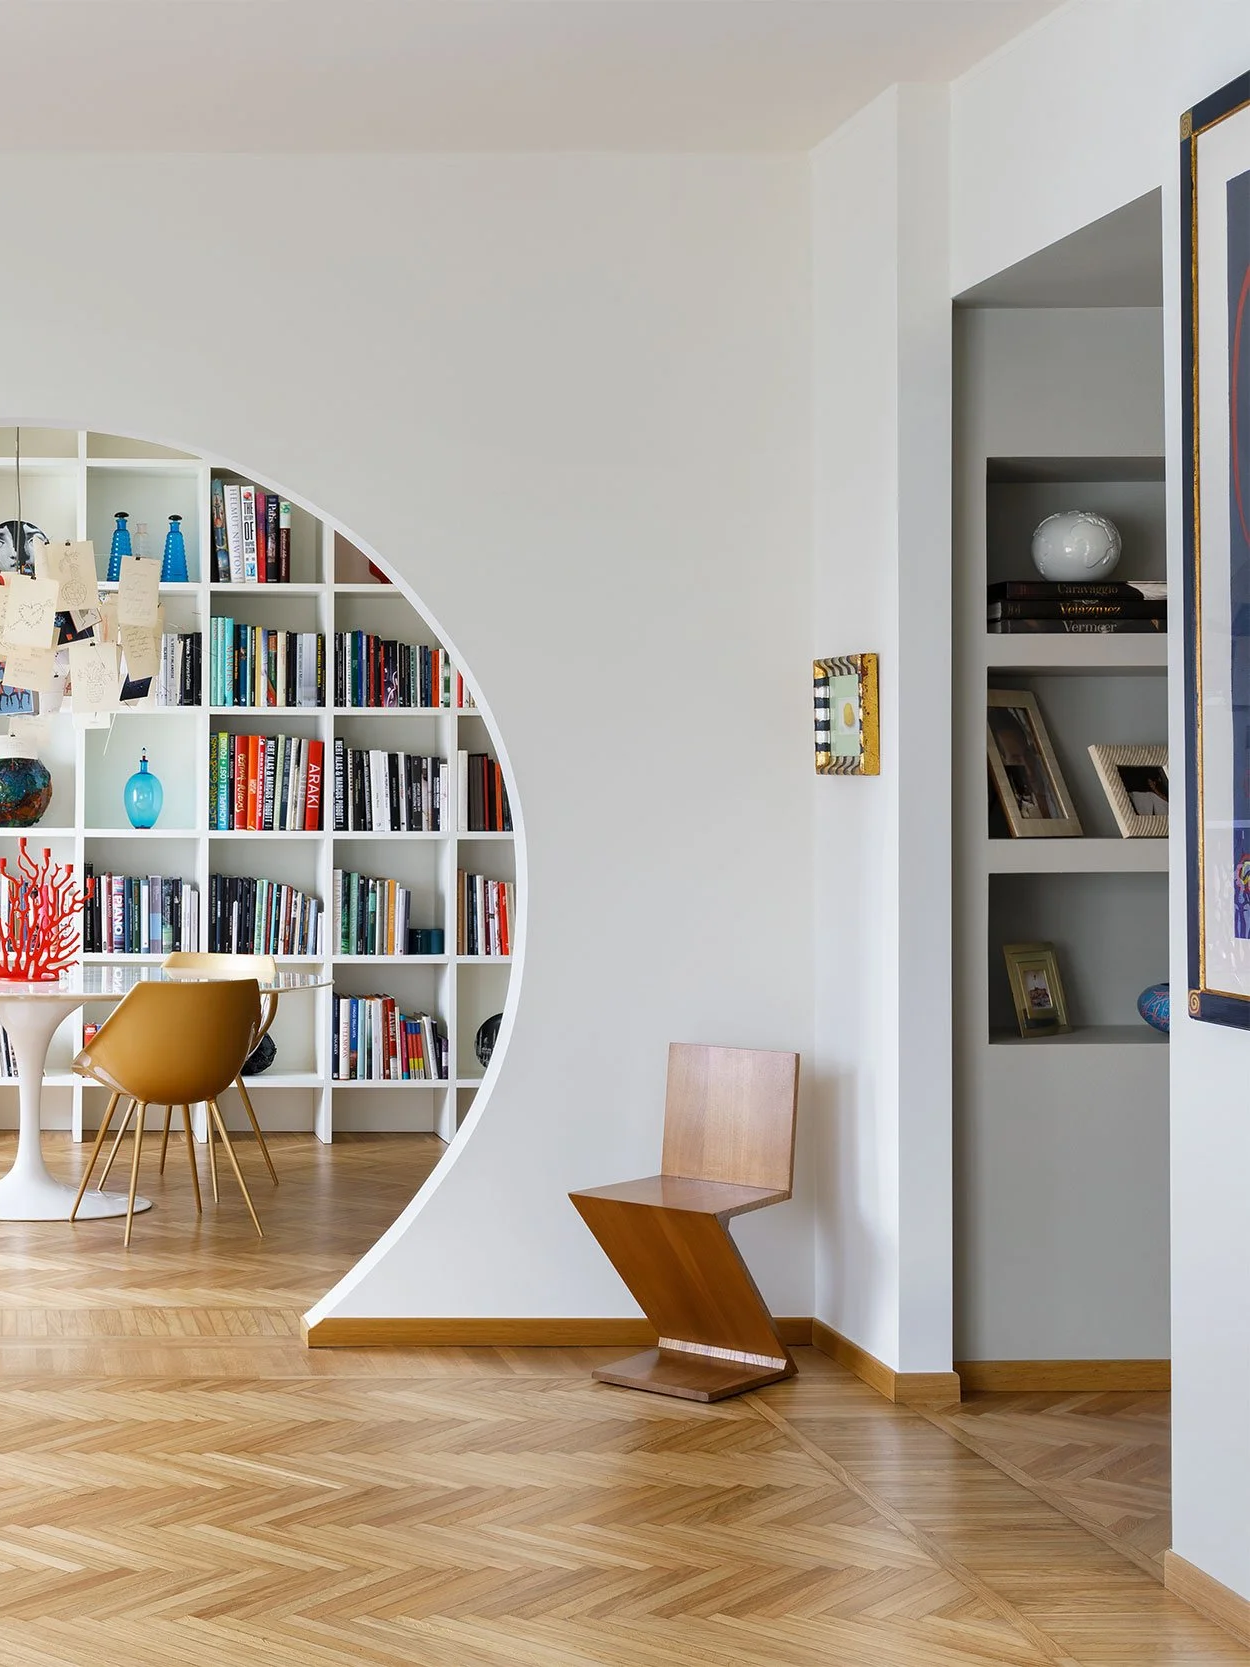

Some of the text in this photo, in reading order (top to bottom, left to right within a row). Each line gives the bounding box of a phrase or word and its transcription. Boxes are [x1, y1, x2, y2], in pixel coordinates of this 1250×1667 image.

[244, 502, 253, 515] THE
[268, 503, 277, 523] Paris
[230, 488, 241, 574] HELMUT NEWTON
[244, 522, 254, 541] OF
[1057, 584, 1118, 596] Caravaggio
[1062, 620, 1118, 632] Vermeer
[266, 740, 275, 756] MERT
[266, 756, 274, 770] ALAS
[219, 767, 227, 784] LOST
[266, 777, 274, 798] MARCUS
[308, 763, 321, 808] ARAKI
[219, 785, 227, 827] LACHAPELLE
[264, 799, 272, 822] PIGGOTT
[114, 894, 124, 934] PIANO
